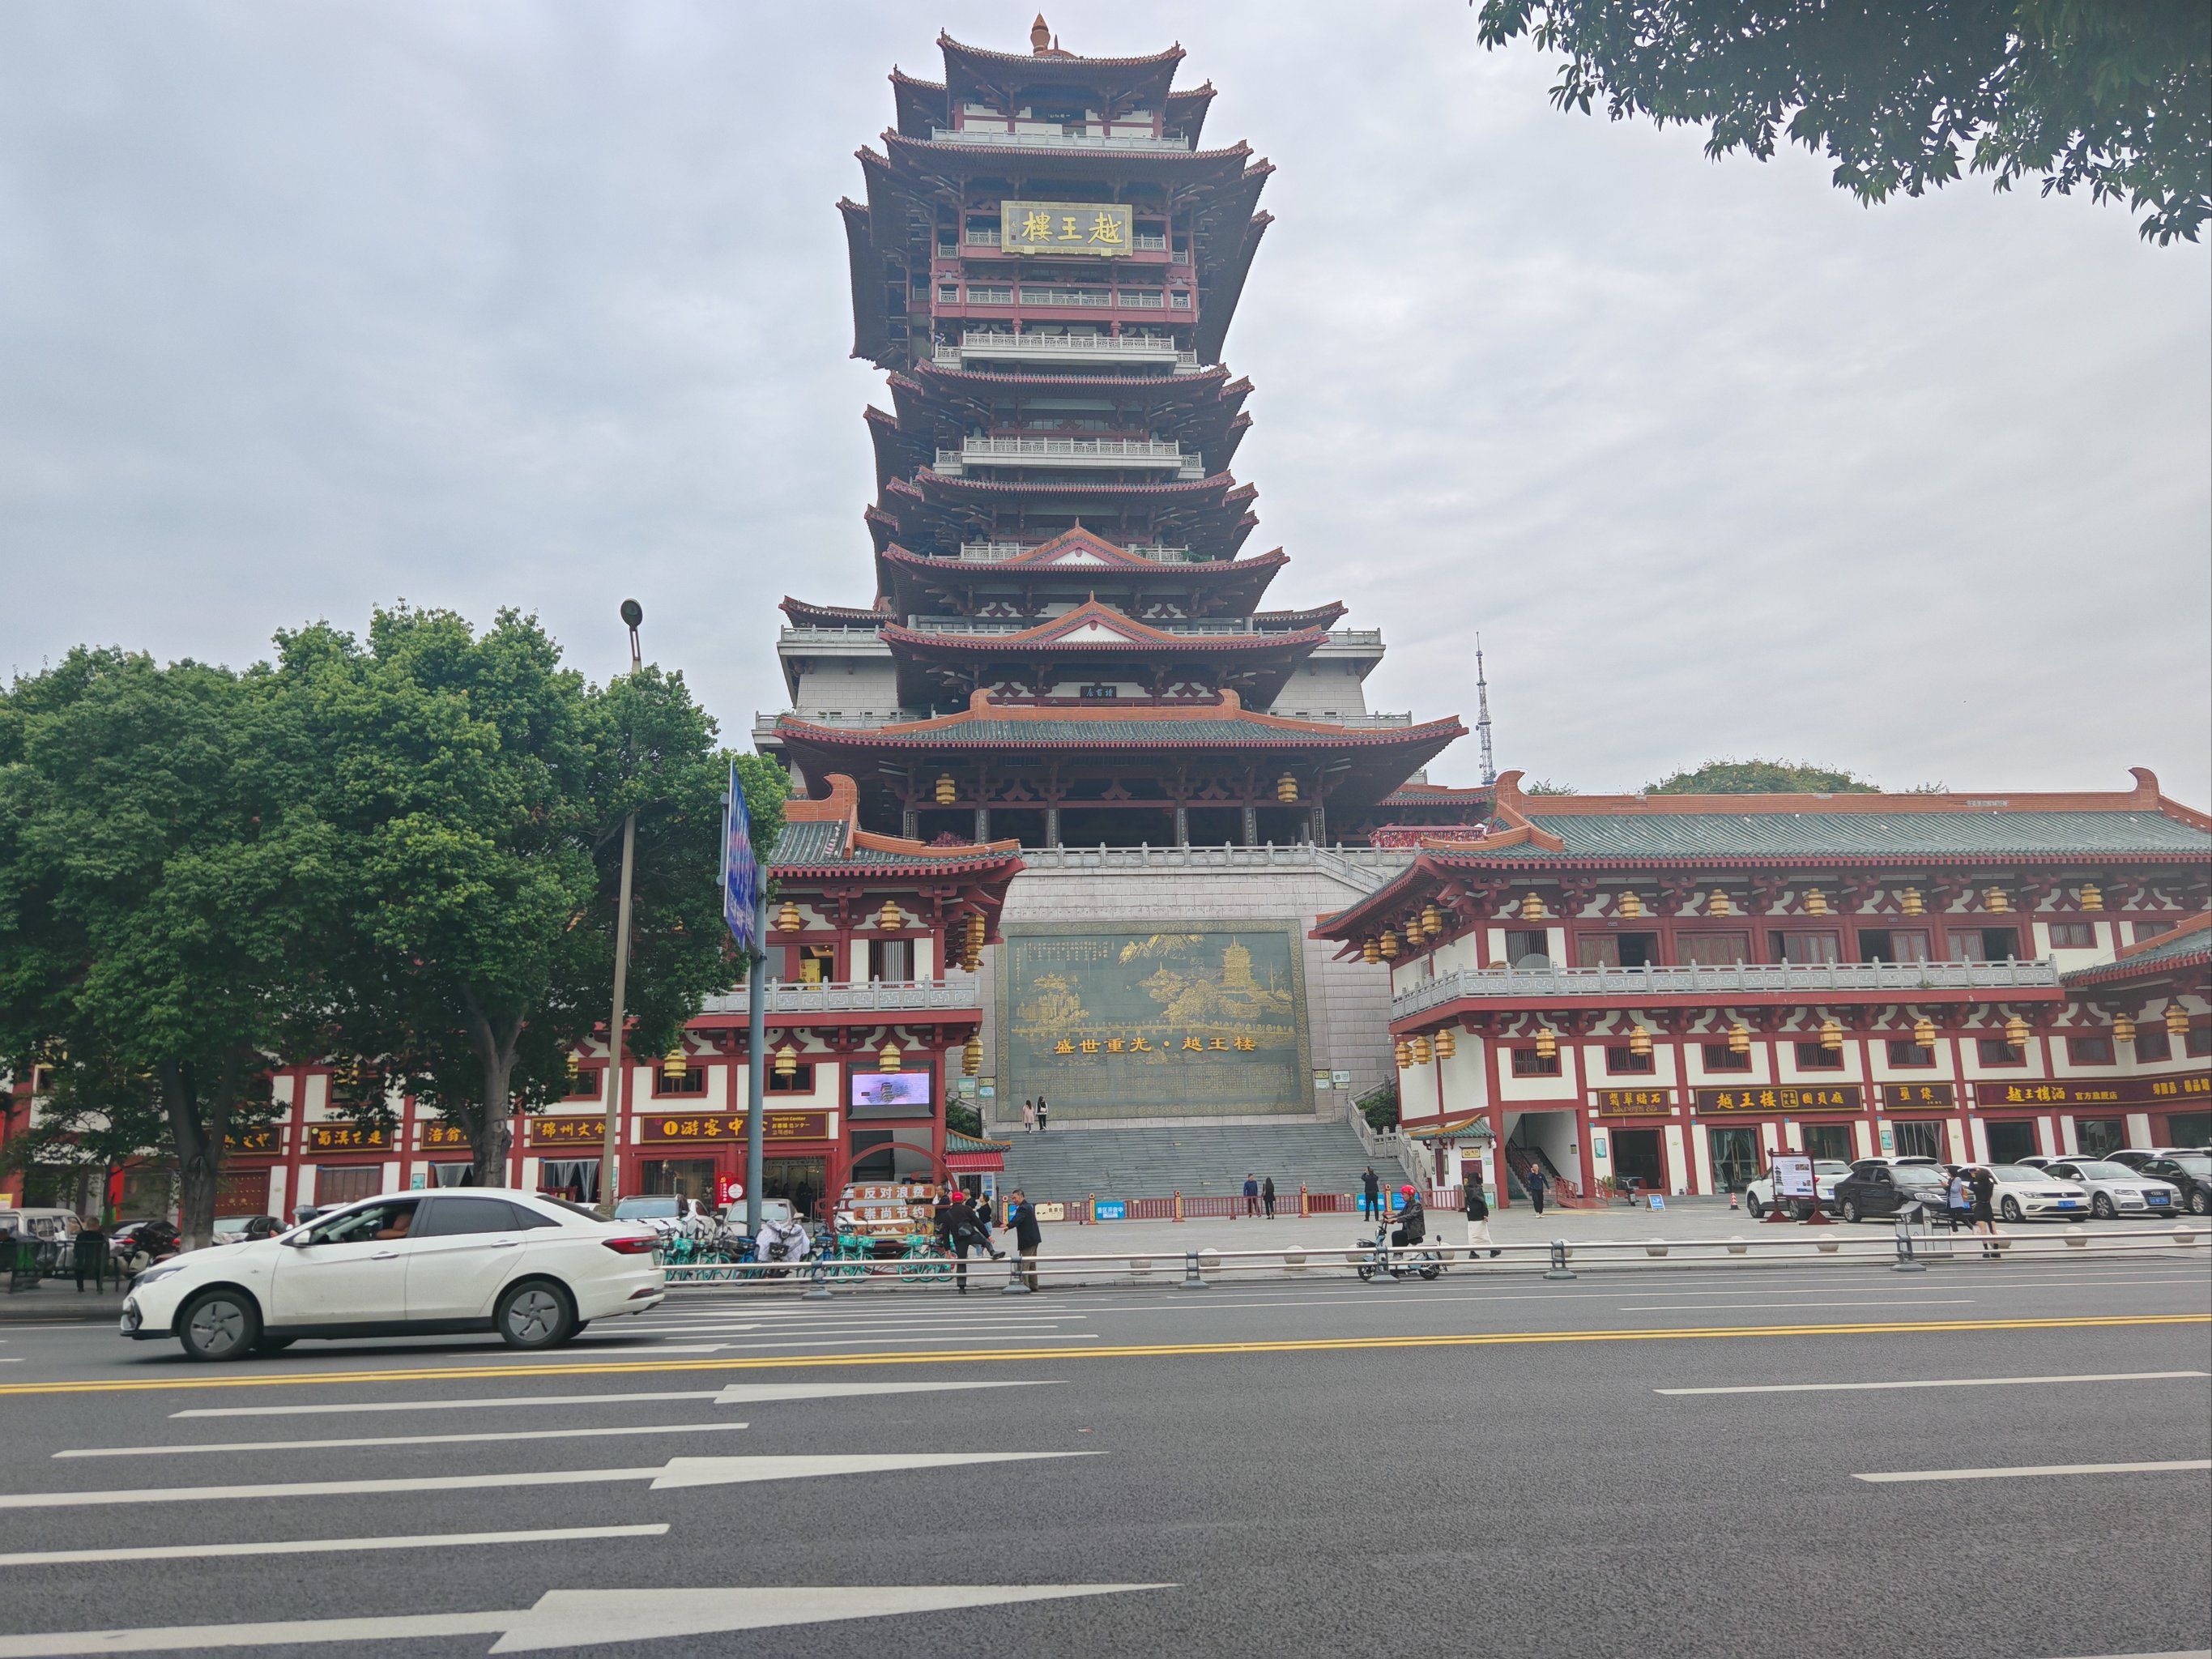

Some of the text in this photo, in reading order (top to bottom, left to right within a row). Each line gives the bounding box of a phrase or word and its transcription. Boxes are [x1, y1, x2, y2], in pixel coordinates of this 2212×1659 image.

[1021, 211, 1123, 244] 越王樓
[428, 1126, 467, 1142] 涪翁
[864, 1186, 925, 1199] 反对浪费
[864, 1205, 925, 1219] 崇尚节约
